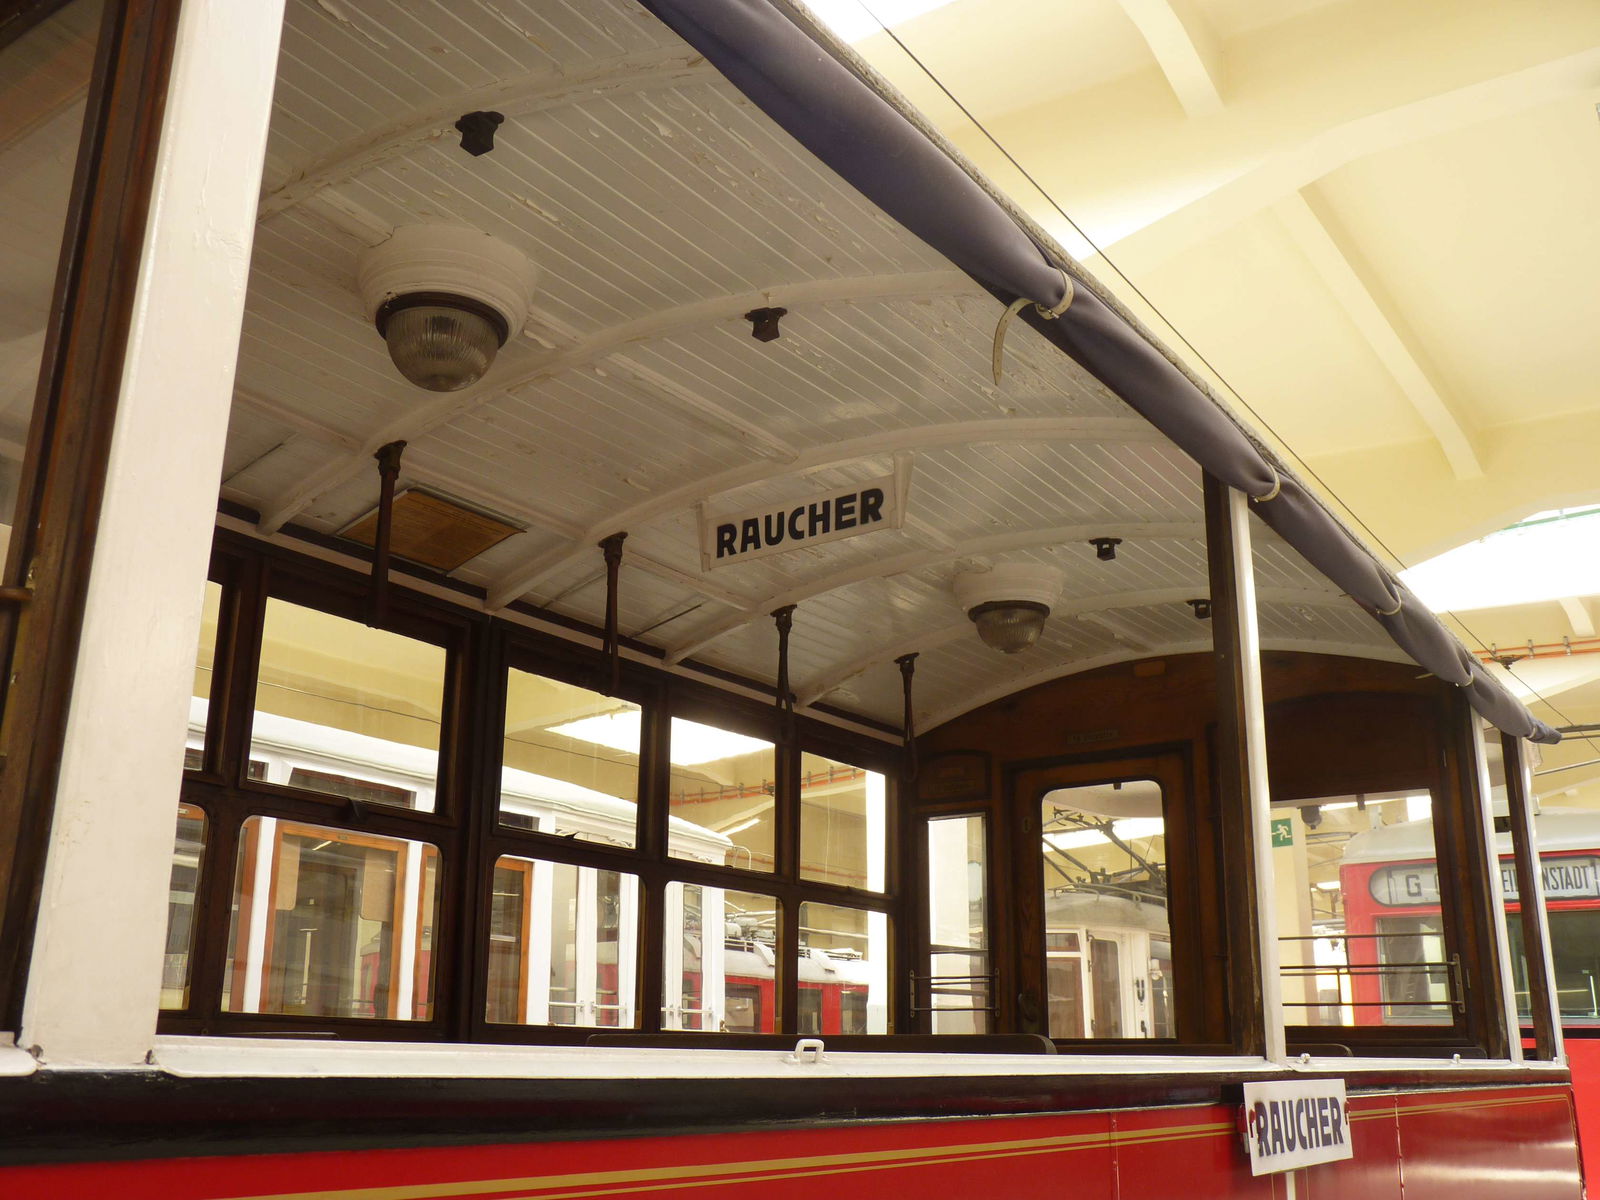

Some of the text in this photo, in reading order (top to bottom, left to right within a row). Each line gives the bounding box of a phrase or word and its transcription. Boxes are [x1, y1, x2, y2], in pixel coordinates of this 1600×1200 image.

[716, 487, 885, 559] RAUCHER
[1405, 874, 1422, 897] G
[1254, 1096, 1344, 1158] RAUCHER
